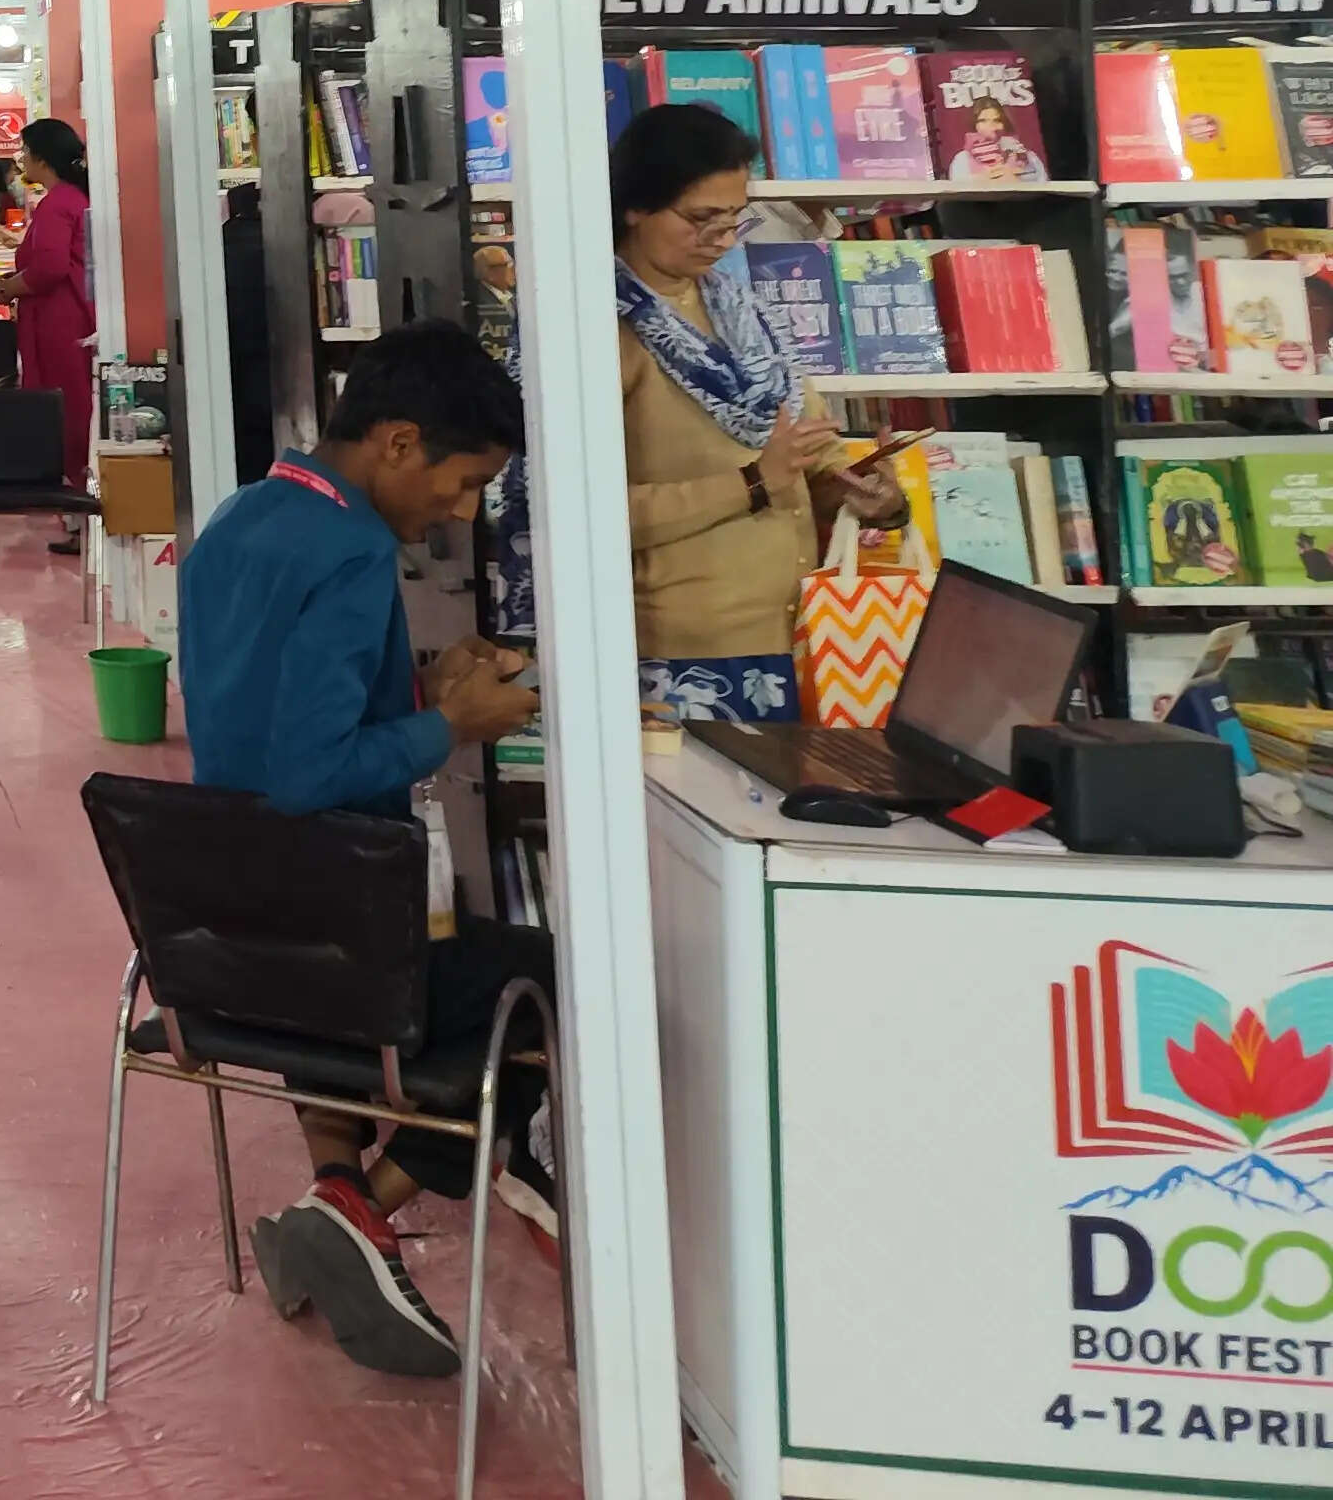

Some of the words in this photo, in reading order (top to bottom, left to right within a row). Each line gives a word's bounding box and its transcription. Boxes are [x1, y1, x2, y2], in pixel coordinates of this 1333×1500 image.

[1071, 1324, 1203, 1368] BOOK
[1219, 1333, 1333, 1376] FEST
[1179, 1404, 1333, 1449] APRIL
